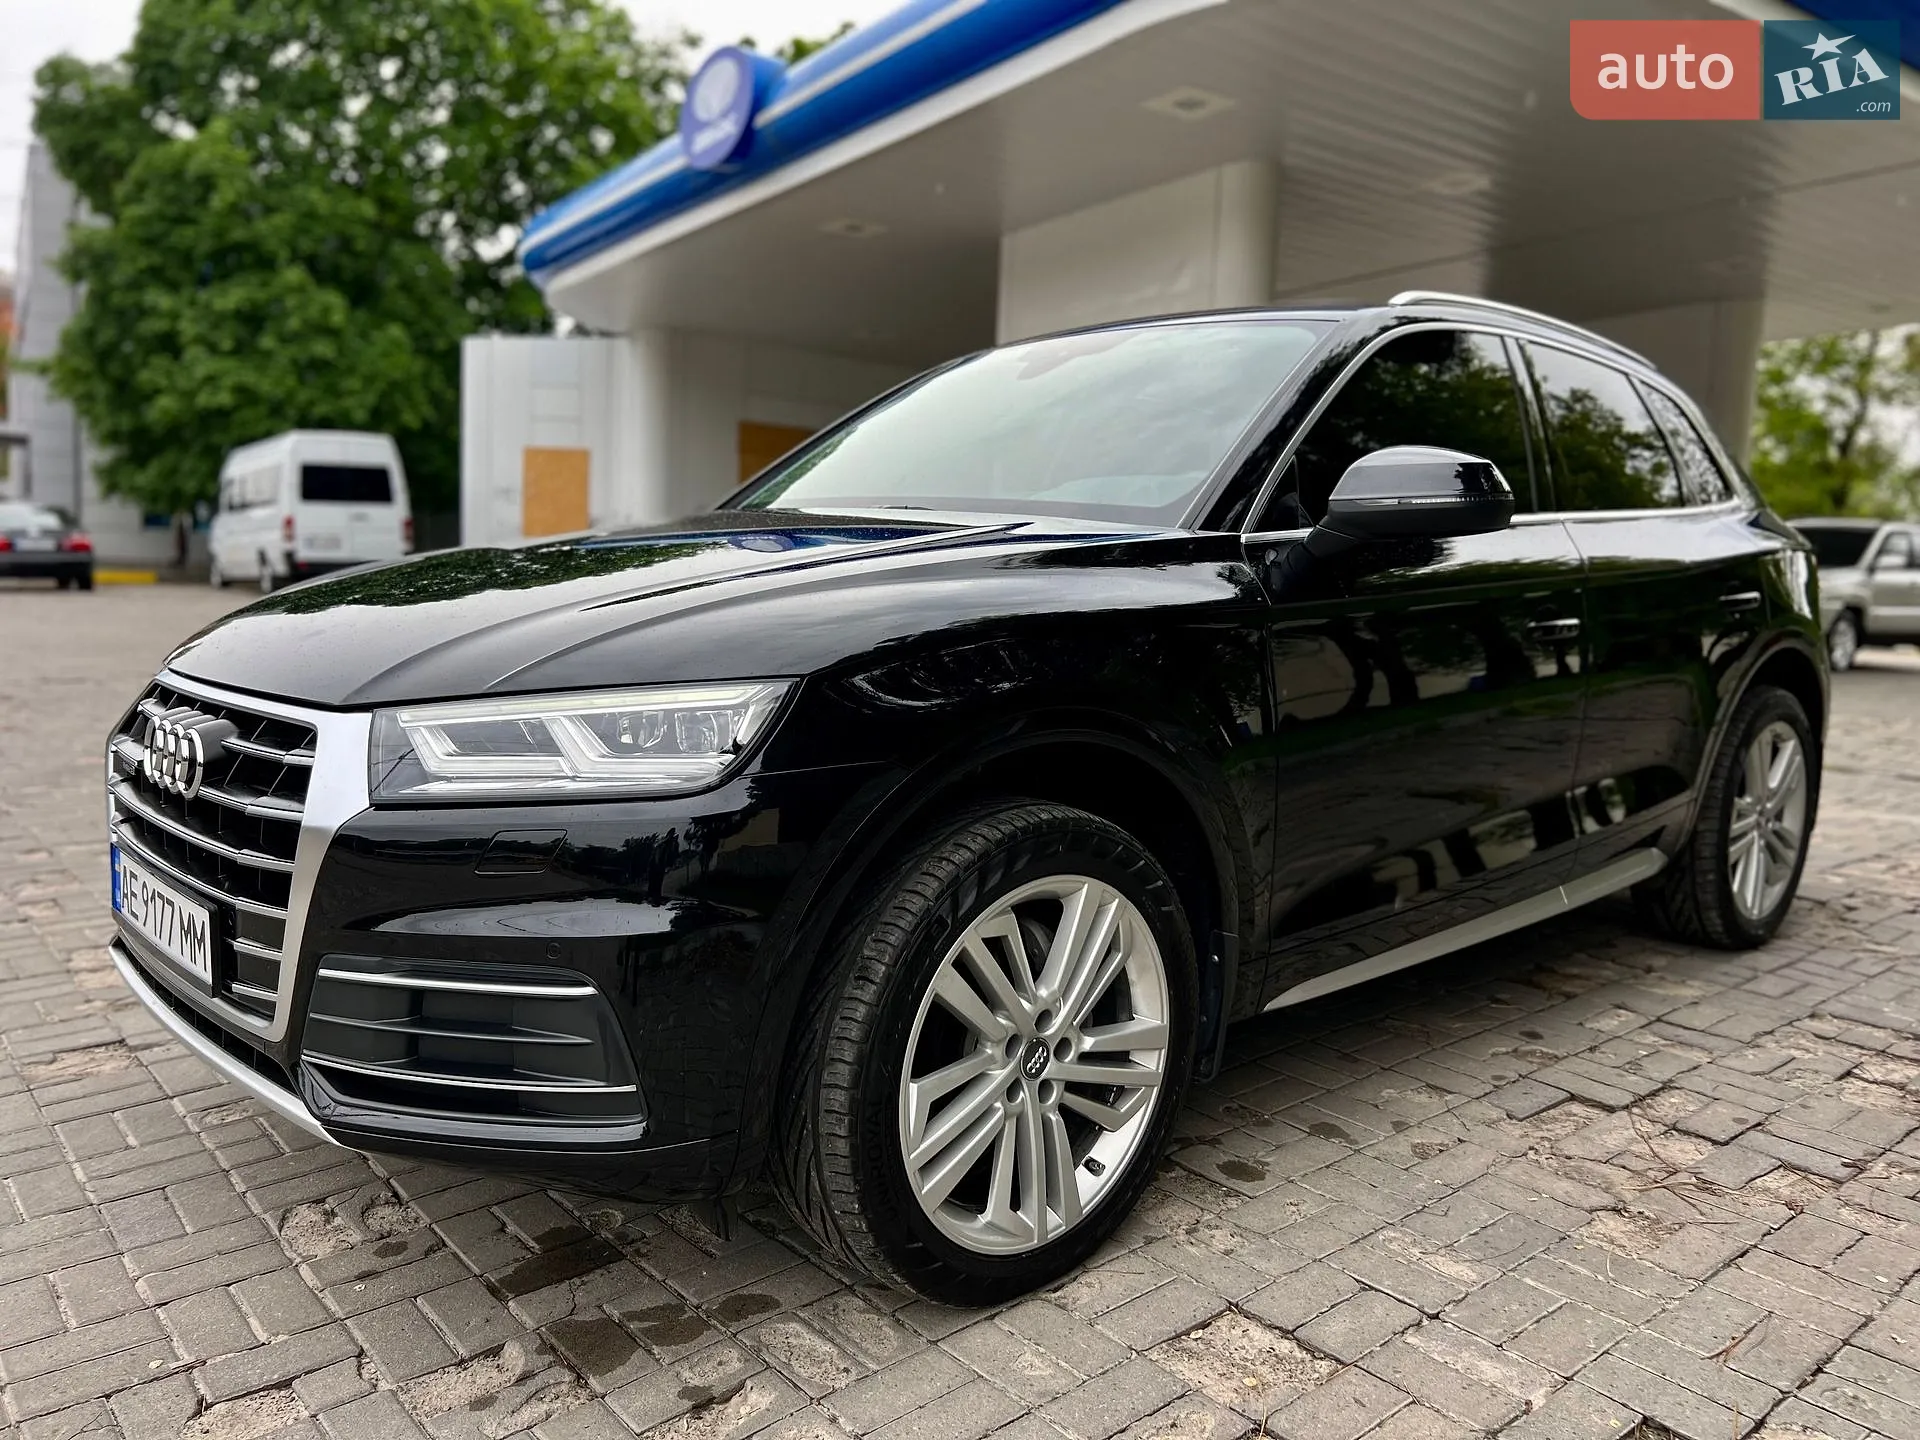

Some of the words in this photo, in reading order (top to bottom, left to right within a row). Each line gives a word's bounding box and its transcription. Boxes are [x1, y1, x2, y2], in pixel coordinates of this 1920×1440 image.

[121, 864, 139, 922] AE
[141, 880, 175, 947] 9177
[178, 905, 208, 973] MM
